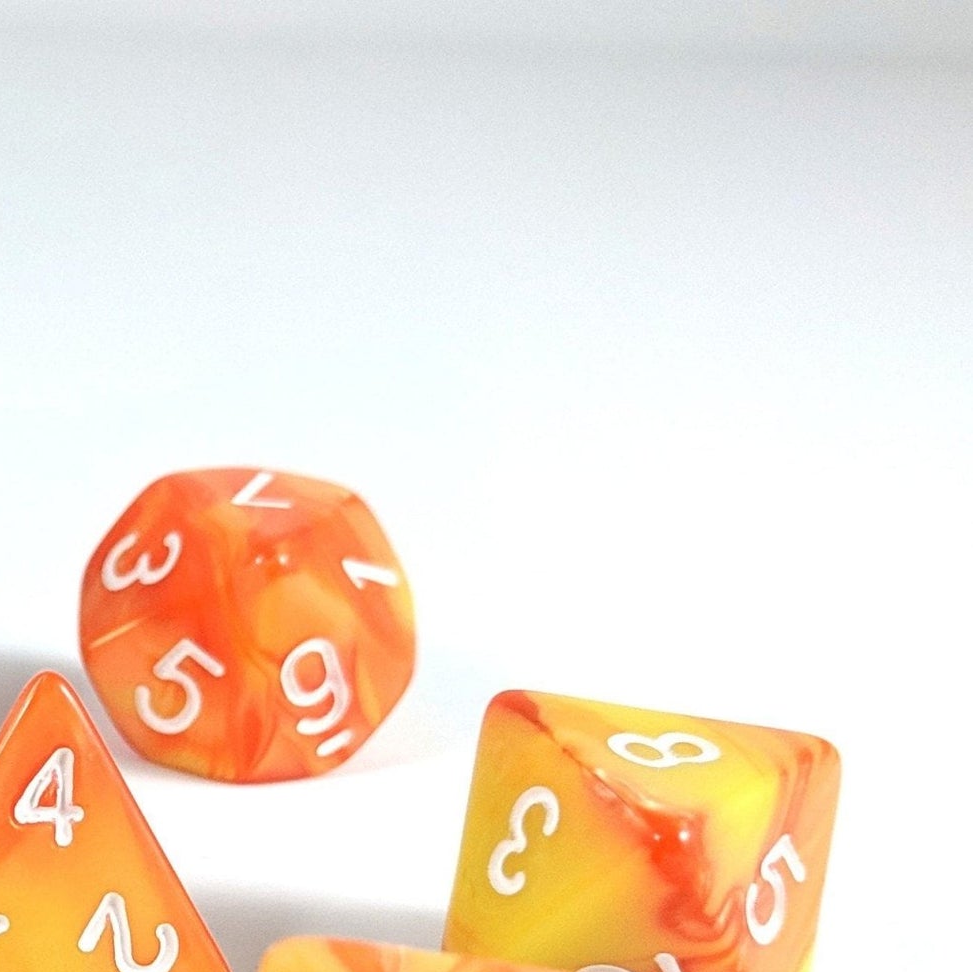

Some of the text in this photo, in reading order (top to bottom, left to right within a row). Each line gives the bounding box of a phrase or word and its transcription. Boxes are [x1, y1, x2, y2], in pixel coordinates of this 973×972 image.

[230, 472, 292, 508] 7
[101, 531, 182, 592] 3
[341, 558, 399, 590] 1
[134, 638, 225, 734] 5
[607, 732, 721, 768] 8
[14, 747, 84, 847] 4
[488, 786, 560, 896] 3
[745, 834, 806, 945] 5
